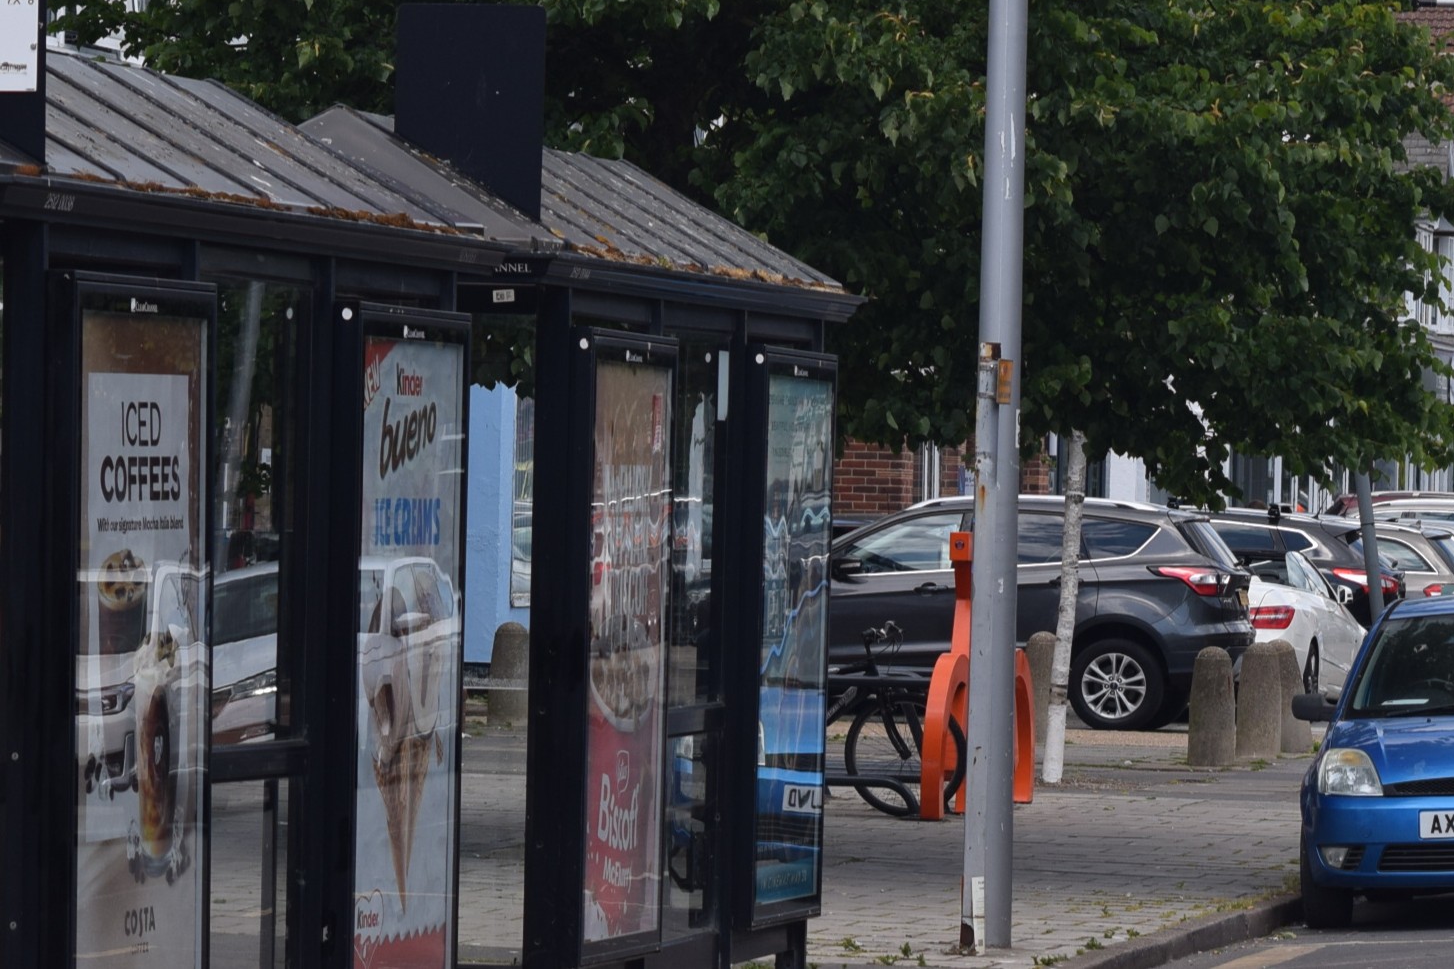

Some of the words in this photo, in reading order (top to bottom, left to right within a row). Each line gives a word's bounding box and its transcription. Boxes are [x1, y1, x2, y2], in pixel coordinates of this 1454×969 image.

[121, 401, 162, 447] ICED
[379, 397, 437, 480] bueno
[100, 455, 181, 503] COFFEES
[96, 517, 109, 533] With
[109, 520, 119, 532] our
[374, 498, 391, 547] ICE
[393, 497, 441, 547] CREAMS
[597, 773, 640, 853] Biscoff
[124, 905, 156, 938] COSTA
